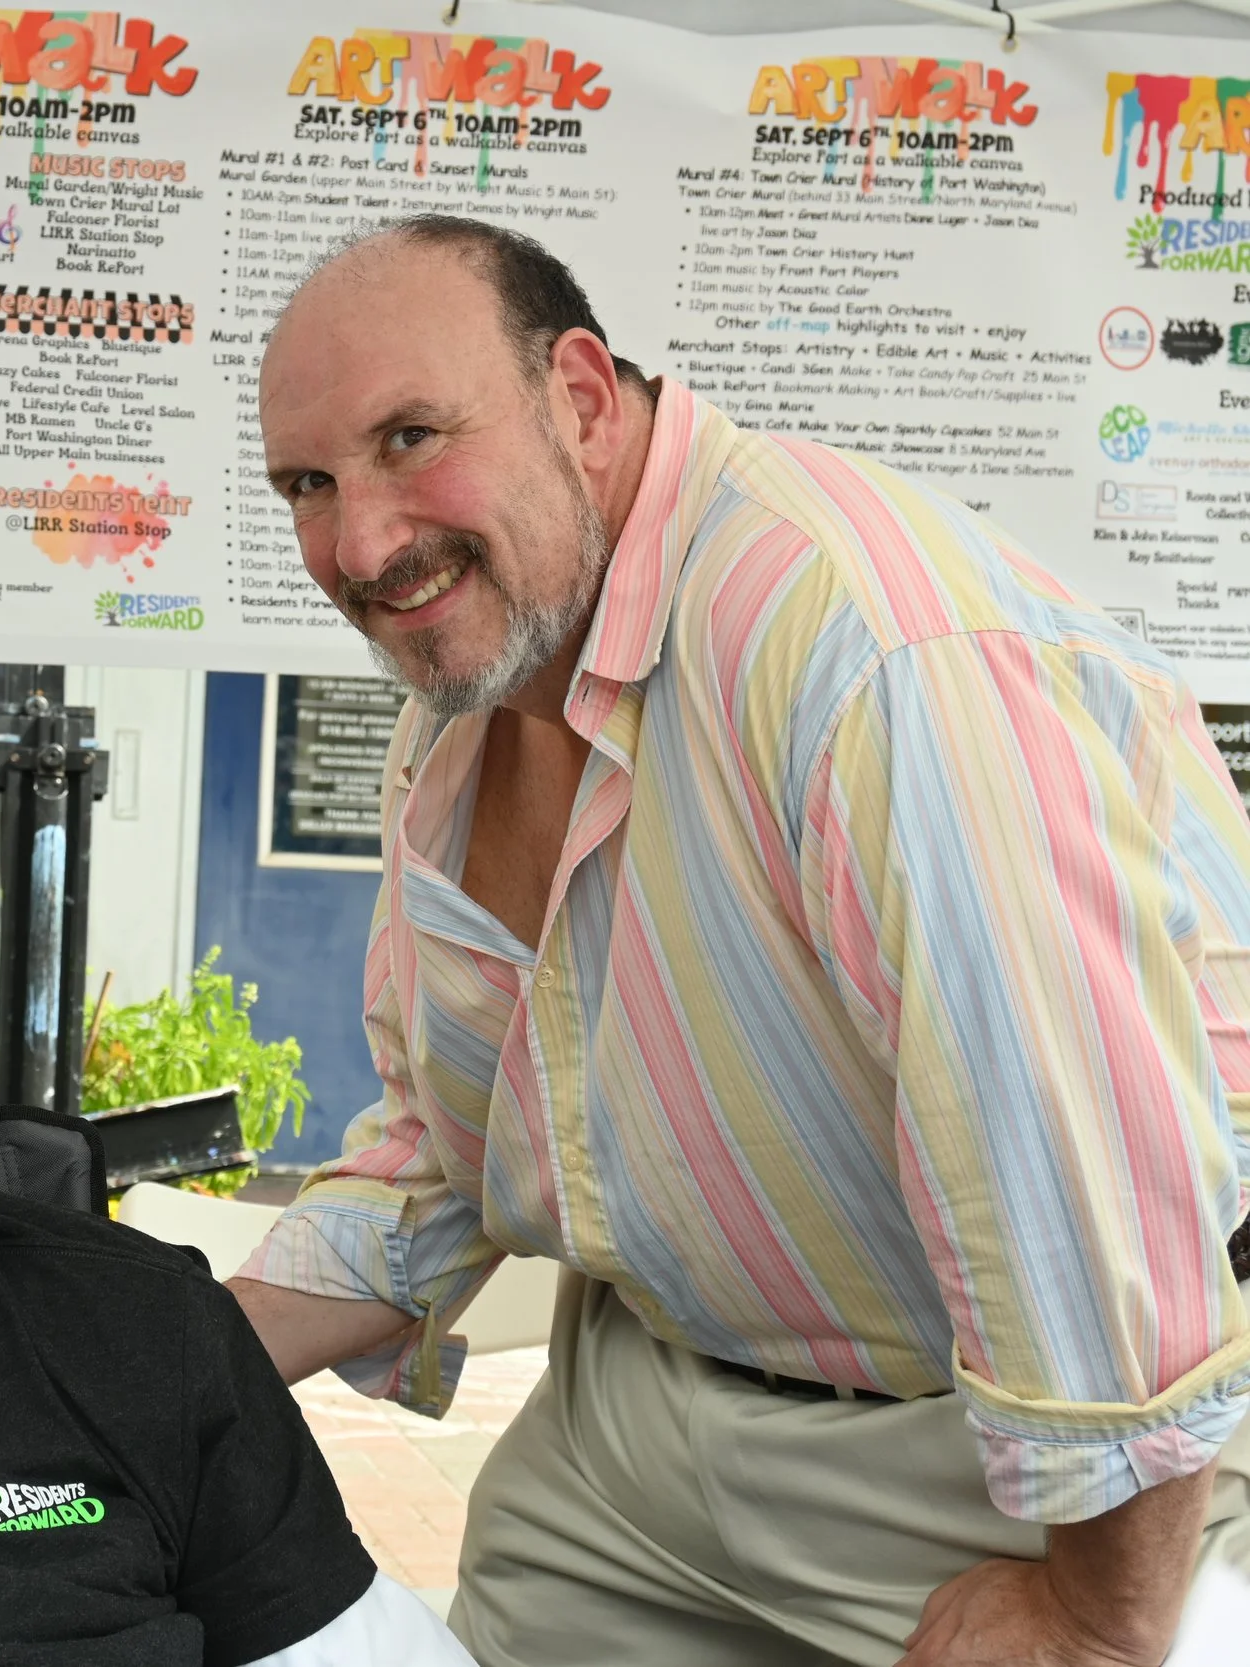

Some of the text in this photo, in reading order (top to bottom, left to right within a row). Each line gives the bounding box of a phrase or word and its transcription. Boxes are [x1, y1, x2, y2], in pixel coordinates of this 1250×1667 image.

[287, 36, 410, 105] ART
[748, 64, 859, 122] ART
[300, 105, 345, 127] SAT,
[75, 127, 141, 144] canvas
[755, 124, 796, 146] SAT,
[30, 154, 186, 182] MUSIC STOPS
[219, 149, 529, 178] Mural #1 & #2: Post Card & Sunset Murals
[6, 177, 204, 200] Mural Garden/Wright Music
[1139, 184, 1242, 209] Produced
[46, 209, 160, 229] Falconer Florist
[39, 225, 165, 248] LIRR Station Stop
[66, 242, 137, 260] Narinatto
[715, 317, 760, 330] Other
[767, 318, 830, 334] off-map
[837, 319, 908, 335] highlights
[914, 323, 929, 335] to
[936, 324, 965, 337] visit
[987, 327, 1026, 342] enjoy
[10, 380, 144, 400] Federal Credit Union
[5, 514, 172, 541] @LIRR Station Stop
[120, 594, 201, 616] RESIDENTS
[122, 608, 203, 631] FORWARD
